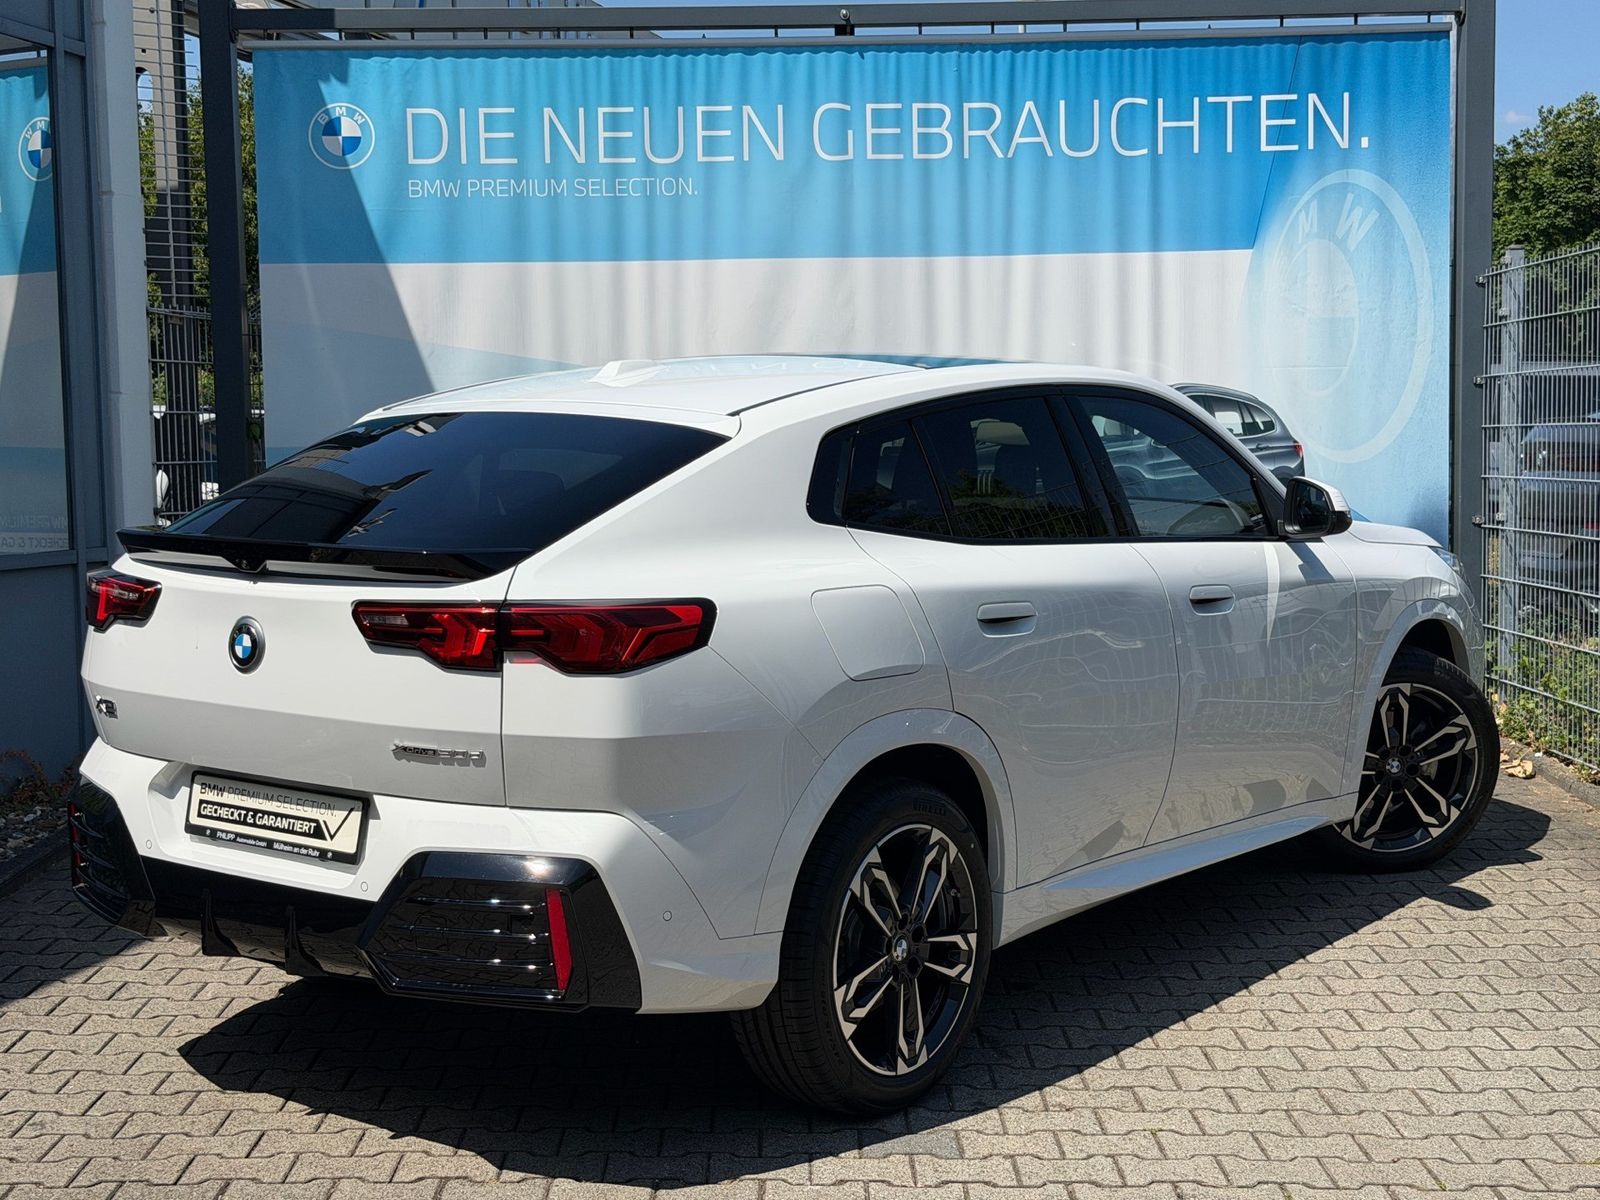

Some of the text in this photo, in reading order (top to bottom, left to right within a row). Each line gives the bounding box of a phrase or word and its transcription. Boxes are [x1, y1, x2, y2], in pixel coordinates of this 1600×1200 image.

[317, 107, 365, 125] BMW
[406, 92, 1369, 165] DIE NEUEN GEBRAUCHTEN.
[408, 177, 698, 198] BMW PREMIUM SELECTION.
[200, 782, 337, 818] BMW PREMIUM SELECTION.
[200, 803, 317, 834] GECHECKT & GARANTIERT
[216, 831, 236, 841] PHILIPP
[308, 848, 320, 857] Ruhr
